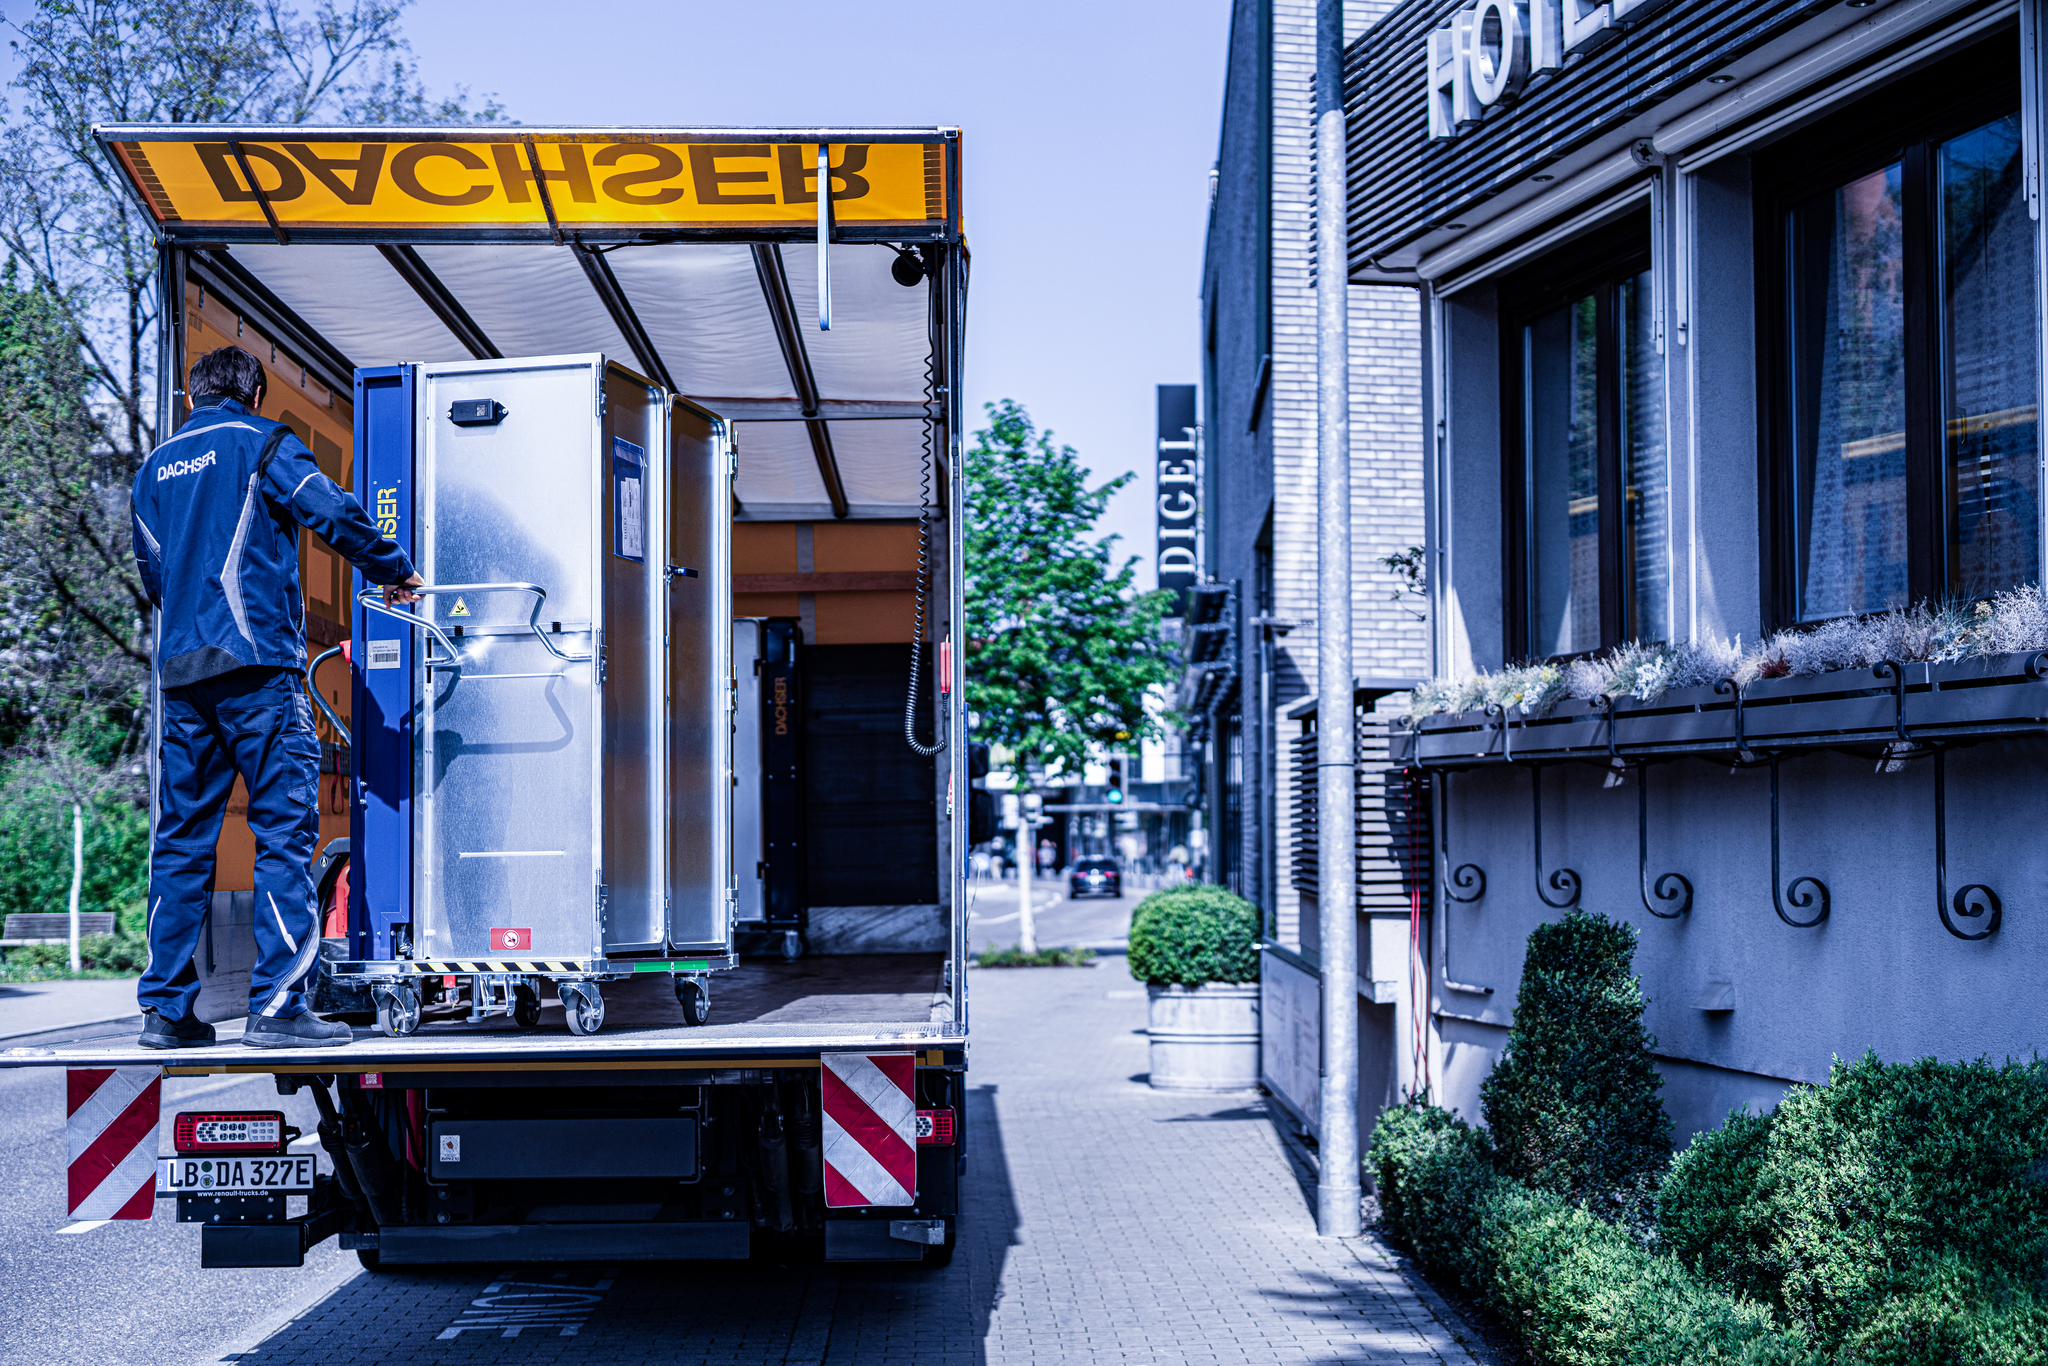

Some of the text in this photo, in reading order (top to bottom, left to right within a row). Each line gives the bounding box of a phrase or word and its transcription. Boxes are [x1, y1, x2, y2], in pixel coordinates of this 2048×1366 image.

[157, 450, 216, 482] DACHSER
[1158, 426, 1196, 575] DIGEL
[774, 676, 787, 735] DACHSER
[169, 1159, 310, 1188] LB DA 327E
[197, 1189, 269, 1197] www.renault-trucks.de
